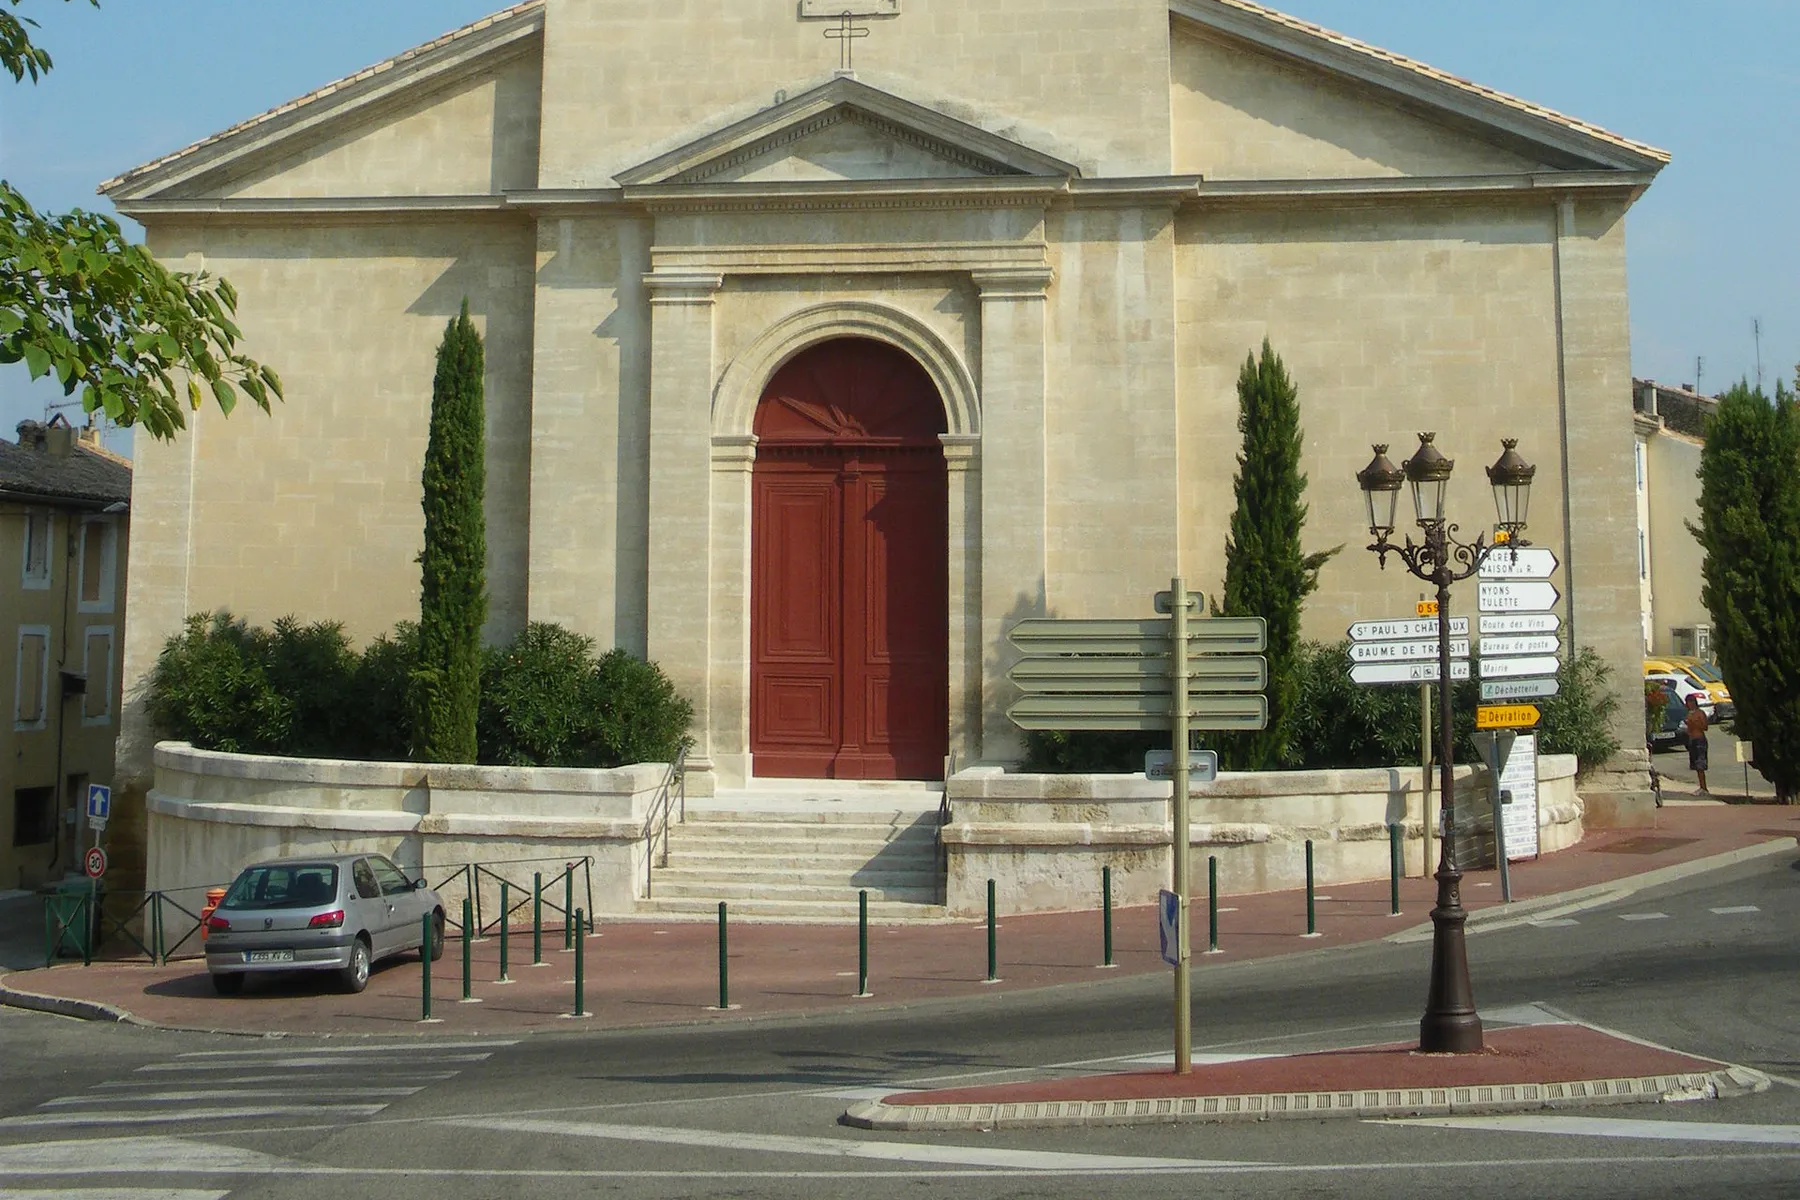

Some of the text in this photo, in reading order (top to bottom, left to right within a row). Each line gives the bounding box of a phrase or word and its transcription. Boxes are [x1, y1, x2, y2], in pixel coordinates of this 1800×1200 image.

[1482, 565, 1513, 573] VAISON
[1482, 586, 1510, 595] NYONS
[1482, 598, 1518, 607] TULETTE
[1418, 604, 1424, 613] D
[1372, 626, 1397, 635] PAUL
[1404, 624, 1409, 633] 3
[1415, 621, 1466, 633] CHÂTAUX
[1482, 619, 1545, 629] Route des Vins
[1358, 643, 1466, 657] BAUME DE TRASIT
[1483, 641, 1549, 651] Bureau de poste
[1453, 666, 1467, 675] Lez
[1483, 664, 1508, 673] Mairie
[1495, 684, 1539, 695] Déchetterie
[1489, 710, 1532, 722] Déviation
[91, 856, 100, 869] 30
